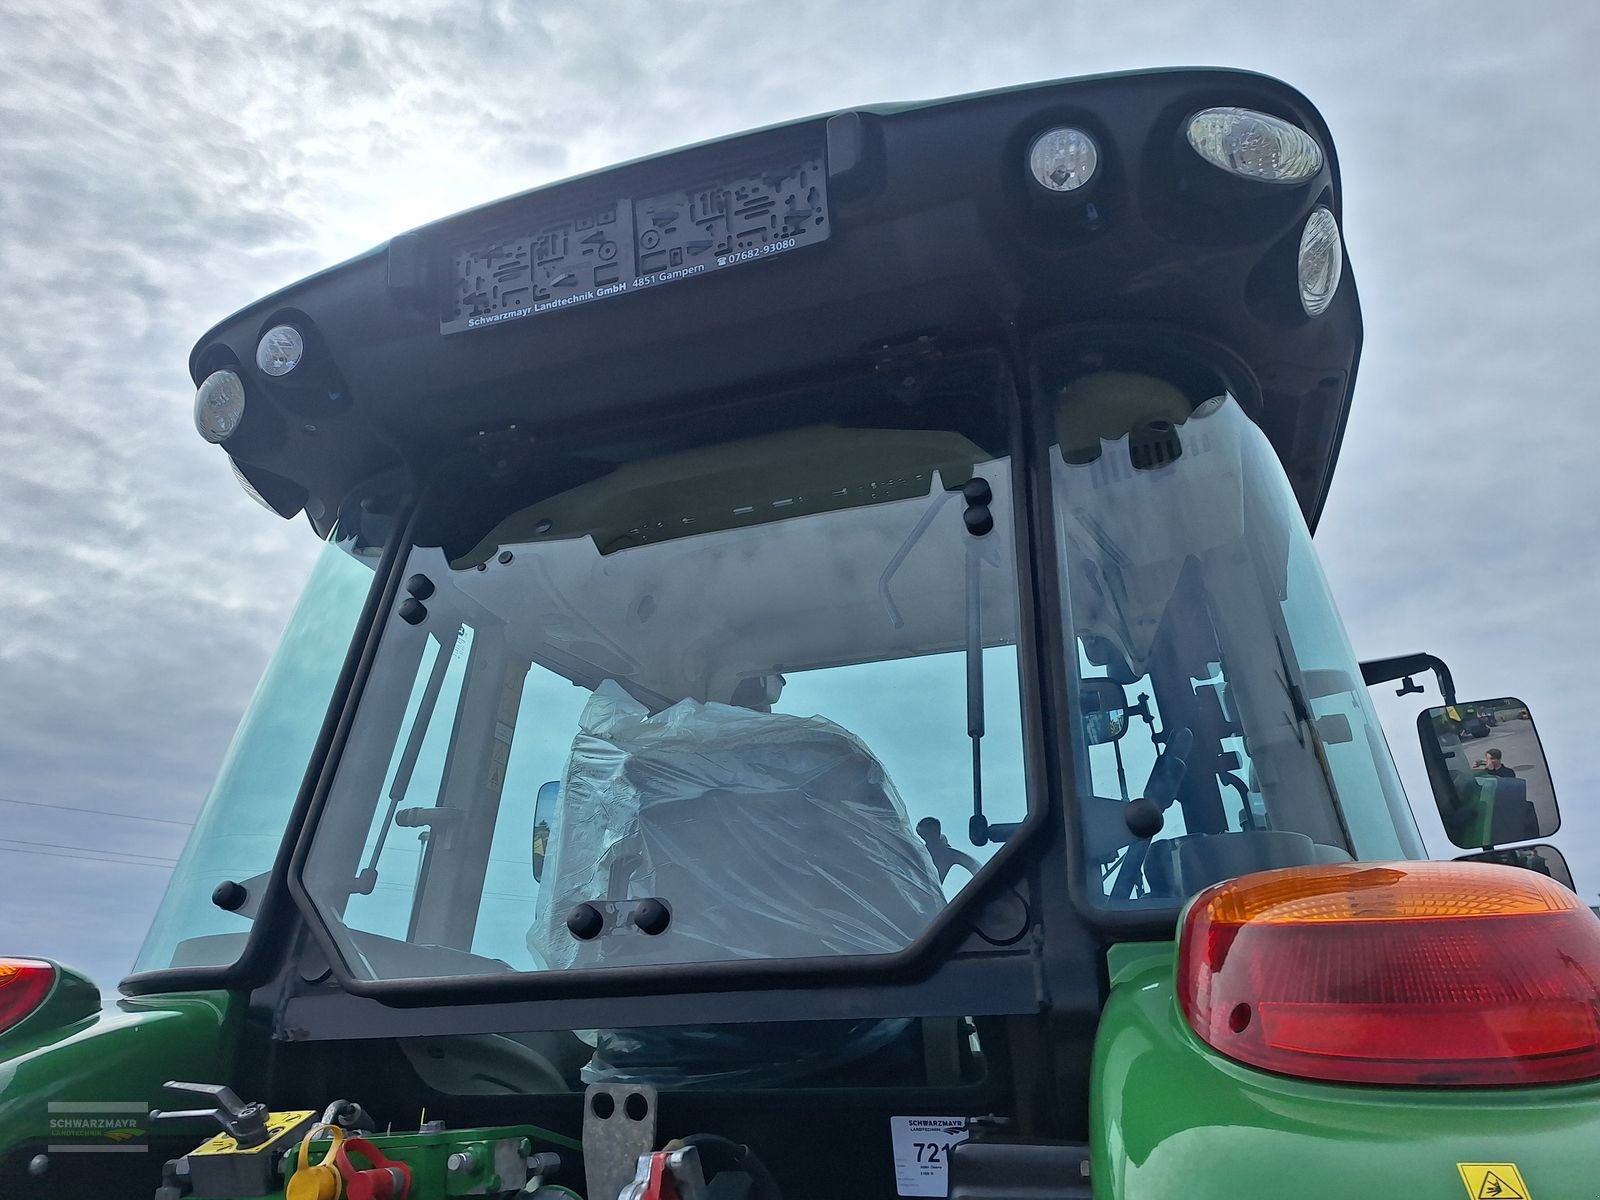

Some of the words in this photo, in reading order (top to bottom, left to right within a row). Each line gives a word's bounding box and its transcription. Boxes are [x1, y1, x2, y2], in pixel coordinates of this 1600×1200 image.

[468, 306, 532, 327] Schwarzmayr
[534, 292, 593, 312] Landtechnik
[596, 282, 627, 297] GmbH
[632, 275, 656, 288] 4851
[659, 265, 705, 281] Gampern
[728, 238, 796, 263] 07682-93080
